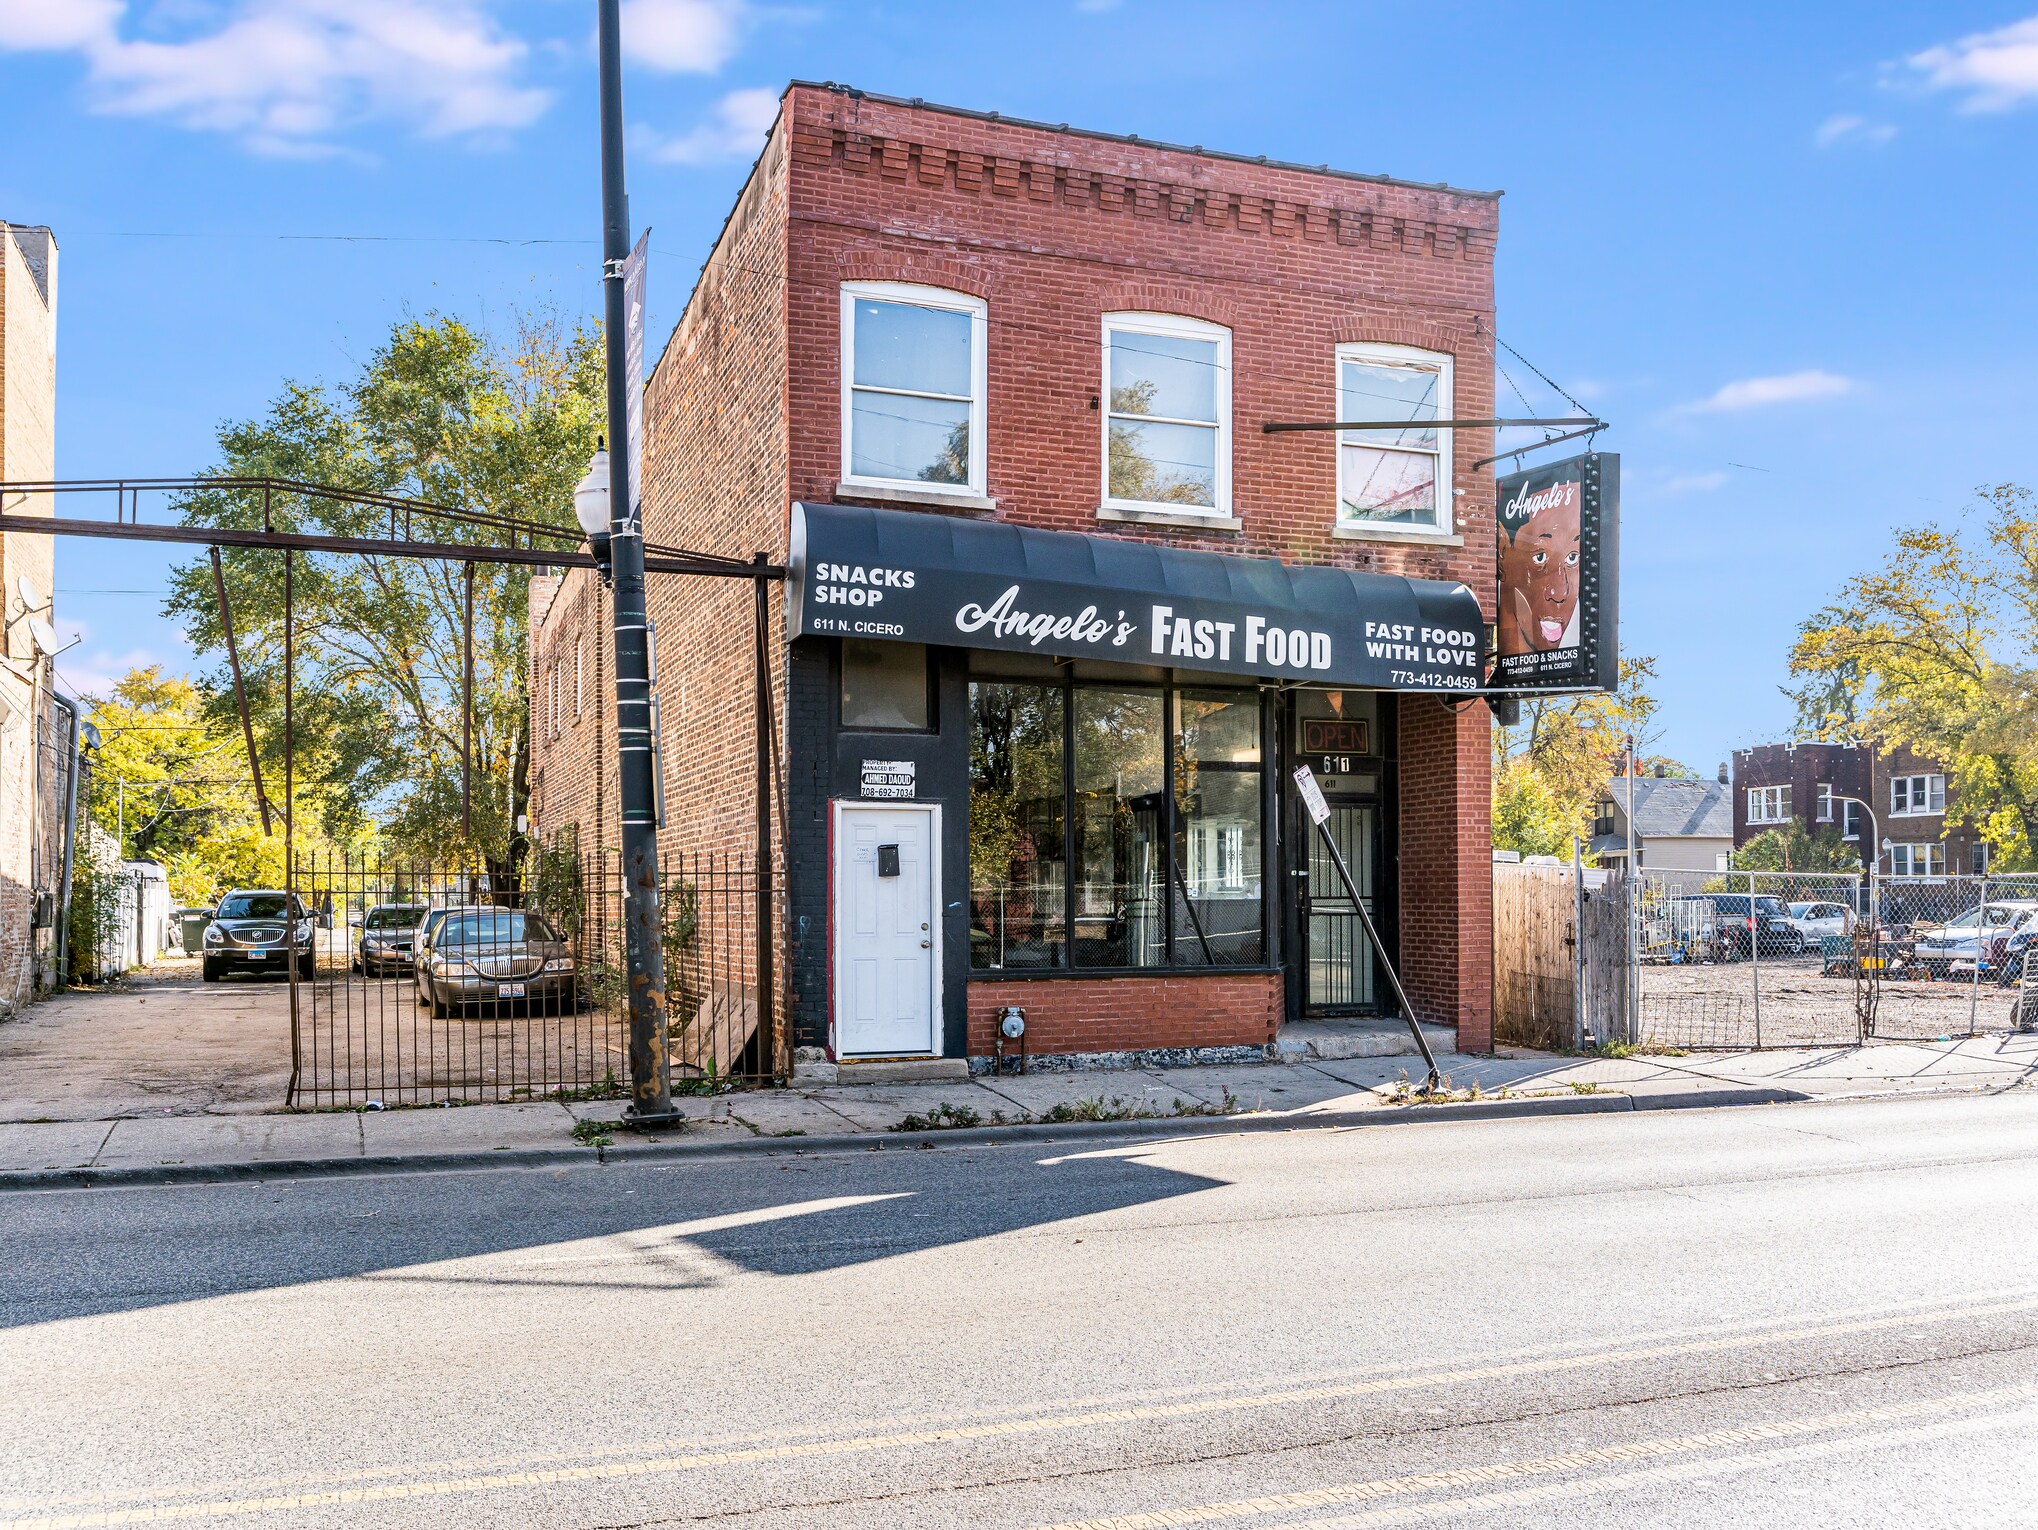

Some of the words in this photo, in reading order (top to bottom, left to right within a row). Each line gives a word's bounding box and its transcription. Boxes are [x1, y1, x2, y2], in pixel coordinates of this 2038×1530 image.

[1505, 480, 1574, 519] Angelo's
[816, 563, 915, 589] SNACKS
[815, 585, 883, 607] SHOP
[813, 618, 834, 631] 611
[838, 620, 851, 632] N.
[854, 621, 904, 636] CICERO
[955, 584, 1138, 646] Angelo's
[1151, 605, 1235, 661] FAST
[1245, 615, 1332, 670] FOOD
[1365, 622, 1415, 641] FAST
[1421, 627, 1476, 647] FOOD
[1365, 642, 1420, 662] WITH
[1426, 647, 1477, 667] LOVE
[1502, 657, 1518, 667] FAST
[1520, 654, 1539, 665] FOOD
[1540, 653, 1546, 662] &
[1547, 649, 1578, 661] SNACKS
[1390, 670, 1477, 689] 773-412-0459
[1308, 725, 1365, 749] OPEN
[1323, 756, 1349, 773] 611
[865, 774, 888, 784] AHMED
[888, 775, 911, 785] DAOUD
[1325, 780, 1336, 788] 611
[861, 788, 913, 797] 708-692-7034
